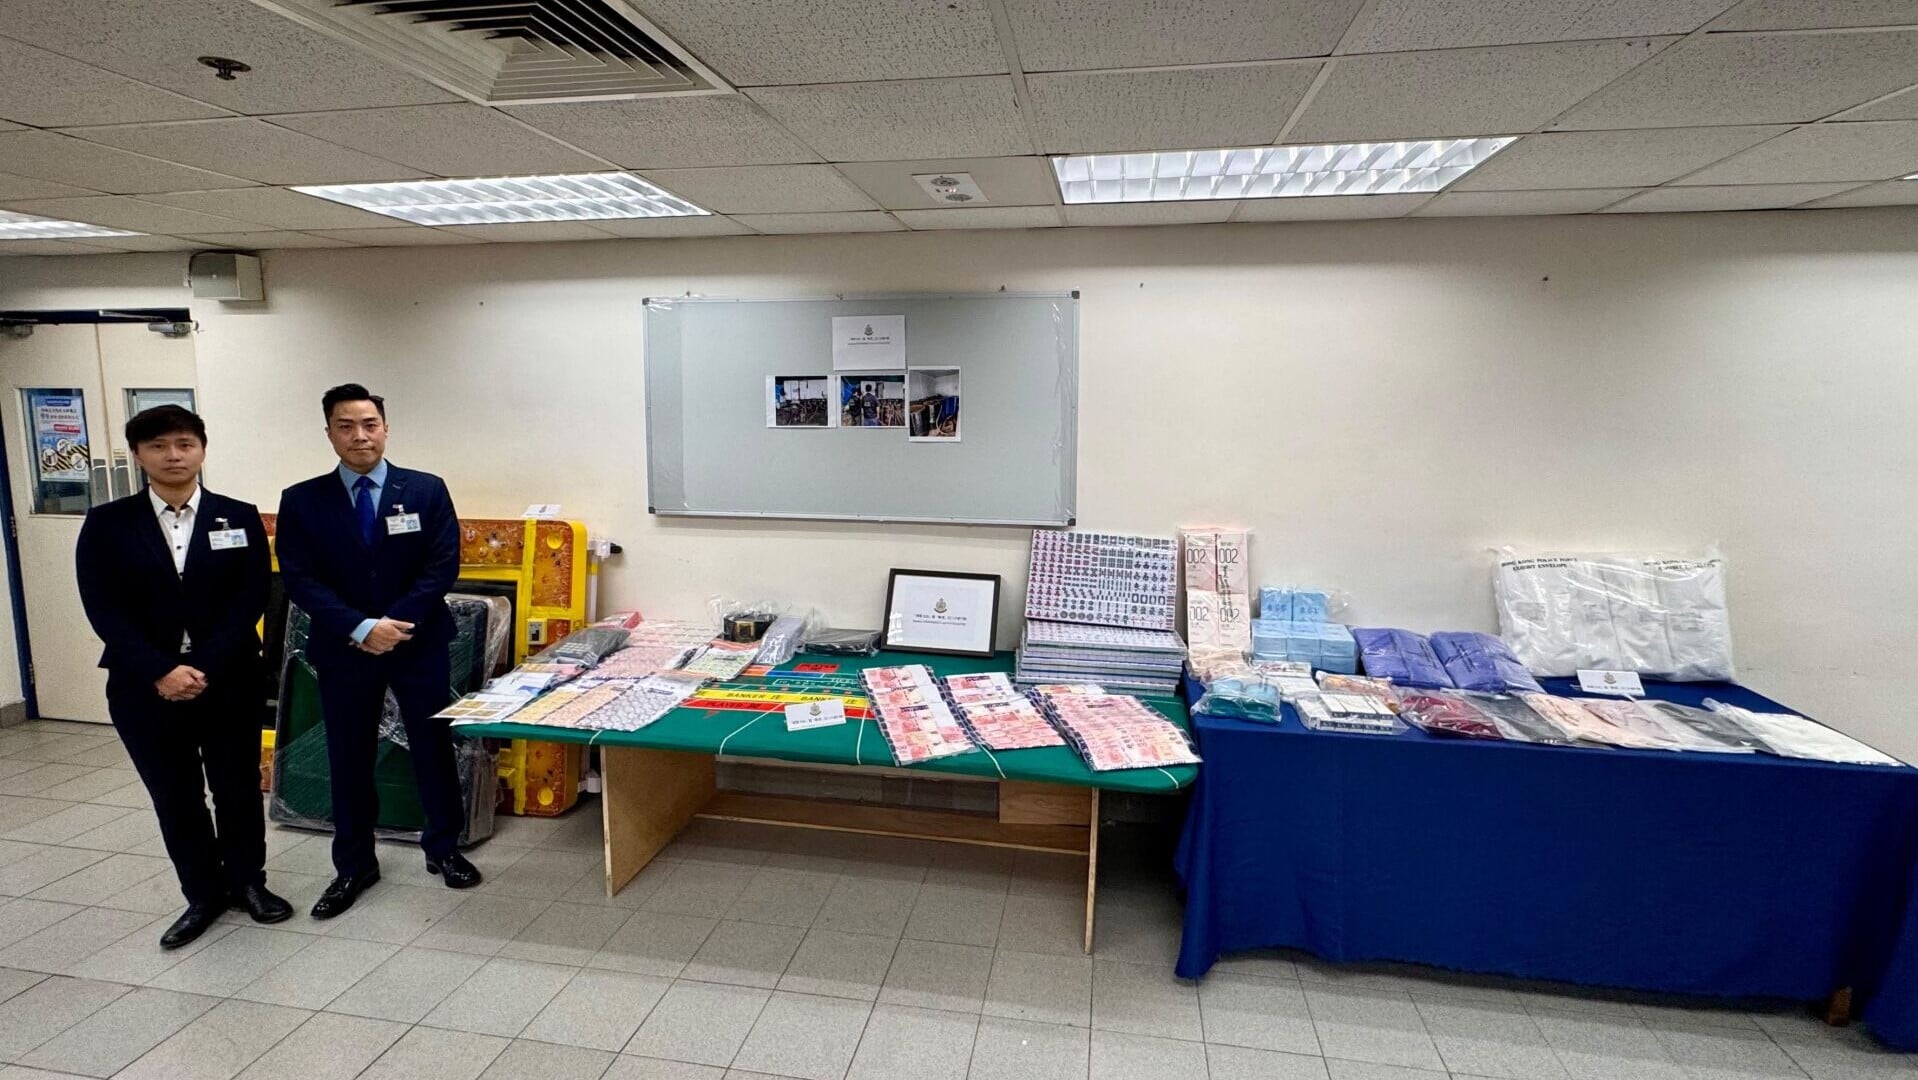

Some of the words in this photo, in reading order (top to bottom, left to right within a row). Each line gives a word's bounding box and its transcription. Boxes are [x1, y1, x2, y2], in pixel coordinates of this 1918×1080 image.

[1187, 549, 1206, 564] 002
[1219, 548, 1238, 563] 002
[1189, 606, 1209, 621] 002
